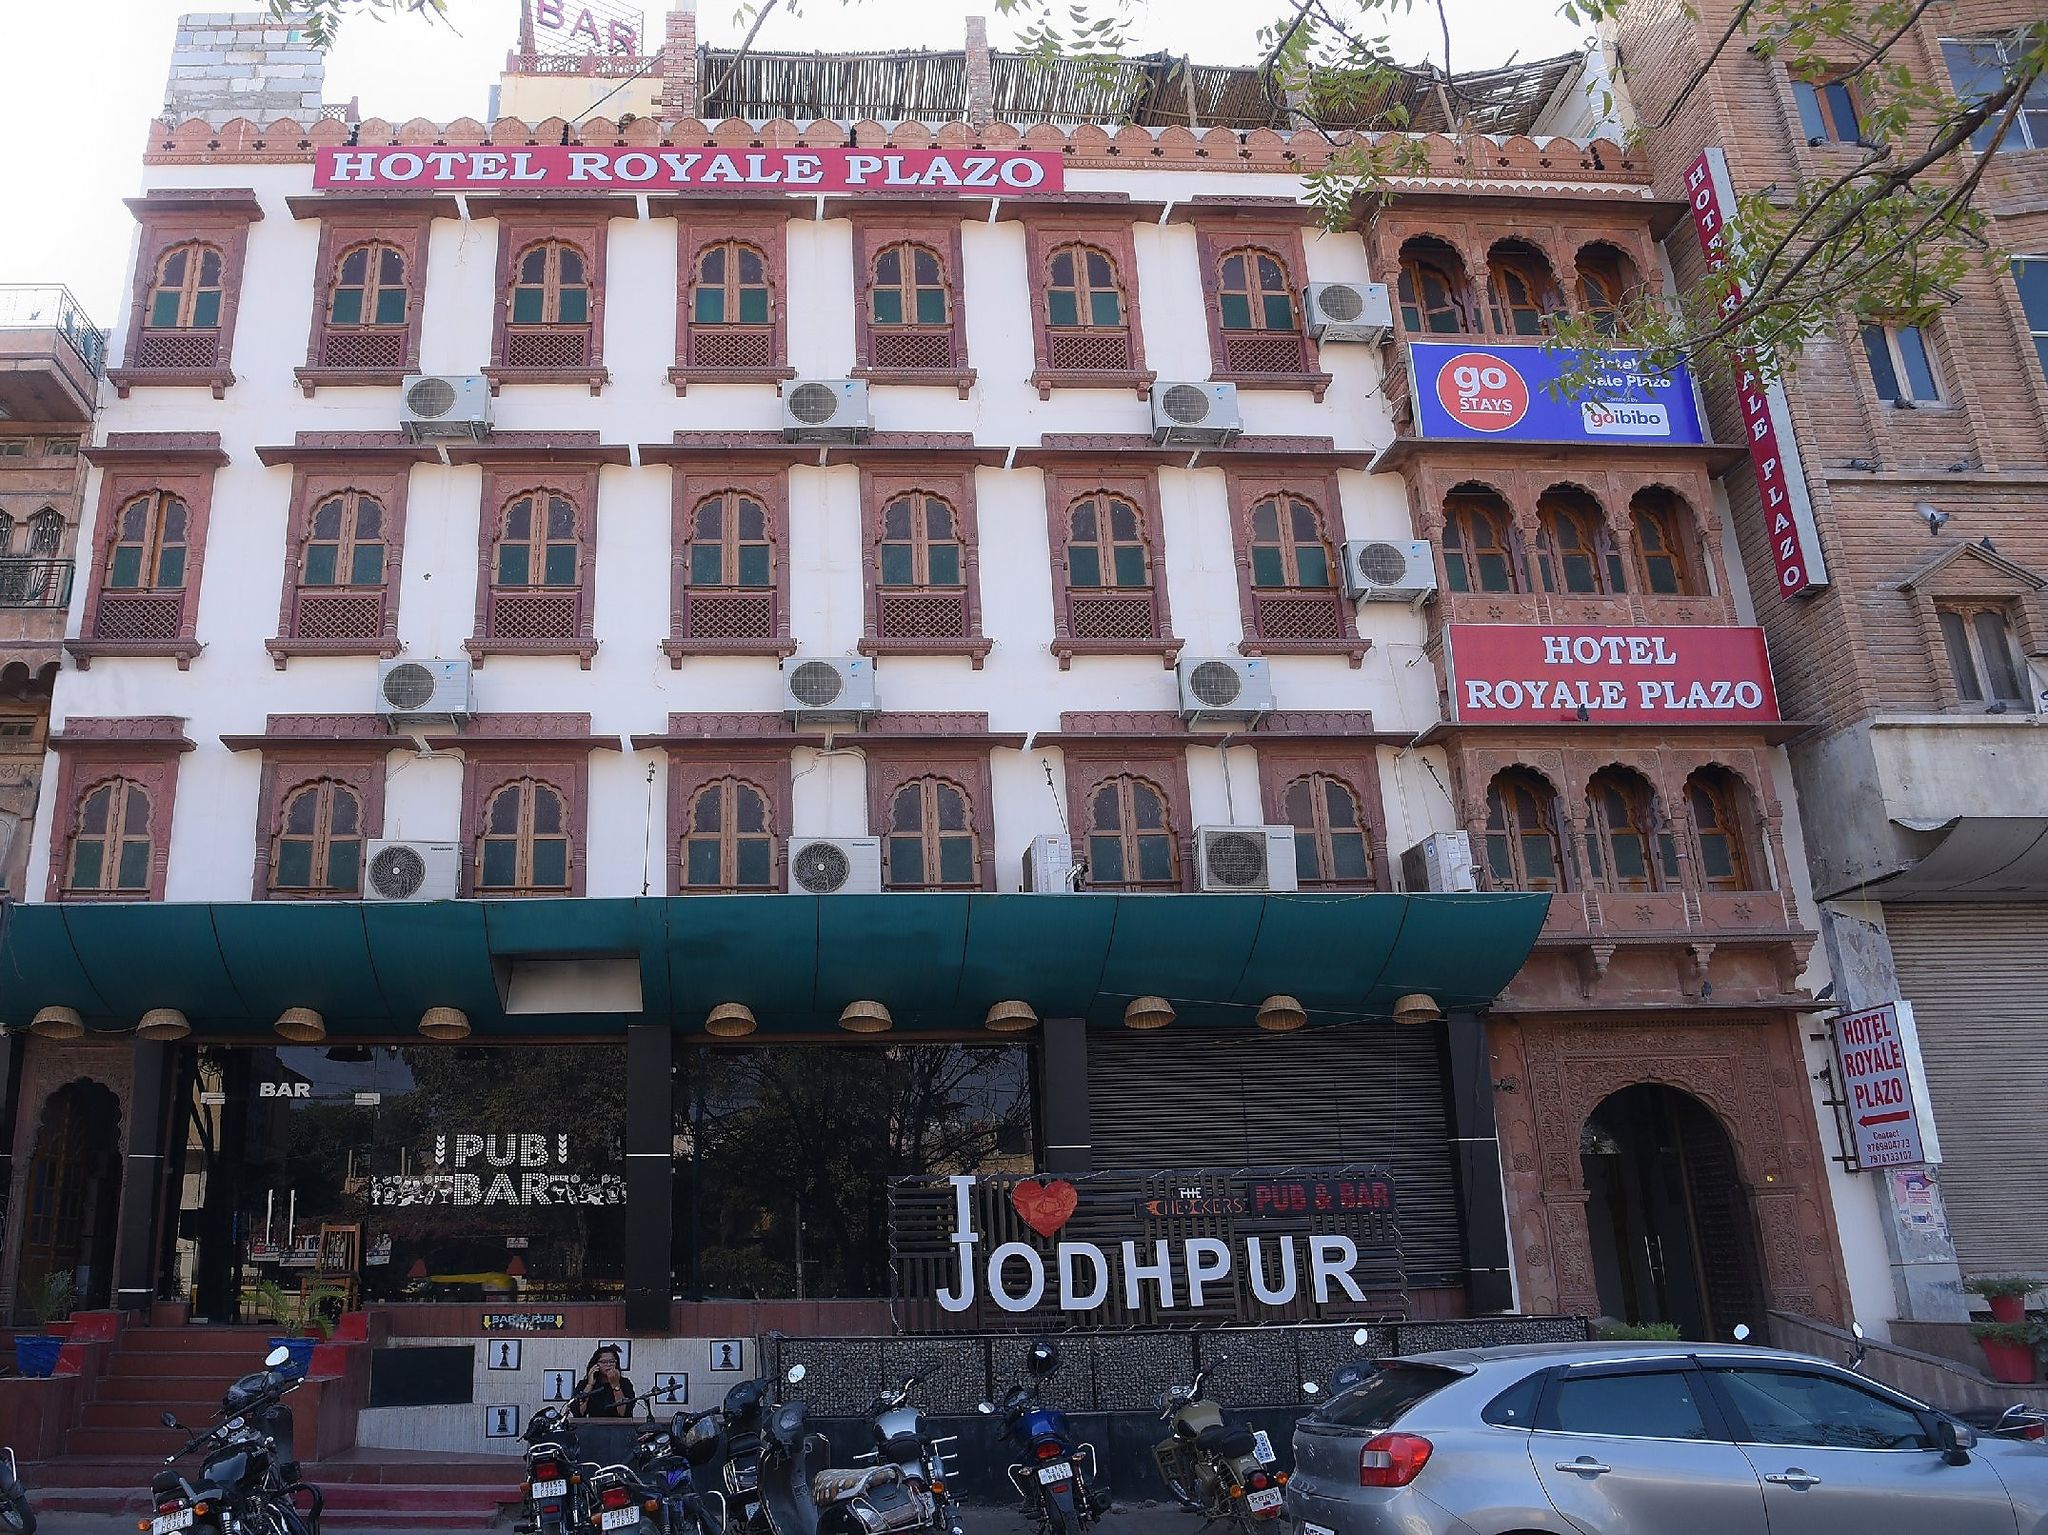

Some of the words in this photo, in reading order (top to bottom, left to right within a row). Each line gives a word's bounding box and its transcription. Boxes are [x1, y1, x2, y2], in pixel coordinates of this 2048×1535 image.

[538, 0, 635, 57] BAR
[329, 152, 547, 181] HOTEL
[567, 153, 824, 184] ROYALE
[845, 155, 1045, 188] PLAZO
[1453, 366, 1507, 397] go
[1460, 397, 1513, 412] STAYS
[1591, 409, 1661, 427] goibibo
[1762, 458, 1800, 587] PLAZO
[1541, 636, 1678, 665] HOTEL
[1465, 680, 1627, 709] ROYALE
[1637, 681, 1763, 709] PLAZO
[1842, 1012, 1892, 1045] HOTEL
[1844, 1041, 1902, 1077] ROYALE
[259, 1082, 311, 1098] BAR
[1854, 1078, 1903, 1109] PLAZO
[455, 1134, 549, 1167] PUB
[1873, 1130, 1900, 1140] Contact
[453, 1173, 551, 1205] BAR
[1178, 1187, 1201, 1199] THE
[1255, 1184, 1307, 1212] PUB
[1339, 1182, 1390, 1208] BAR
[949, 1175, 978, 1242] I
[936, 1235, 1368, 1312] JODHPUR
[492, 1315, 516, 1324] BAR
[531, 1315, 555, 1323] PUB
